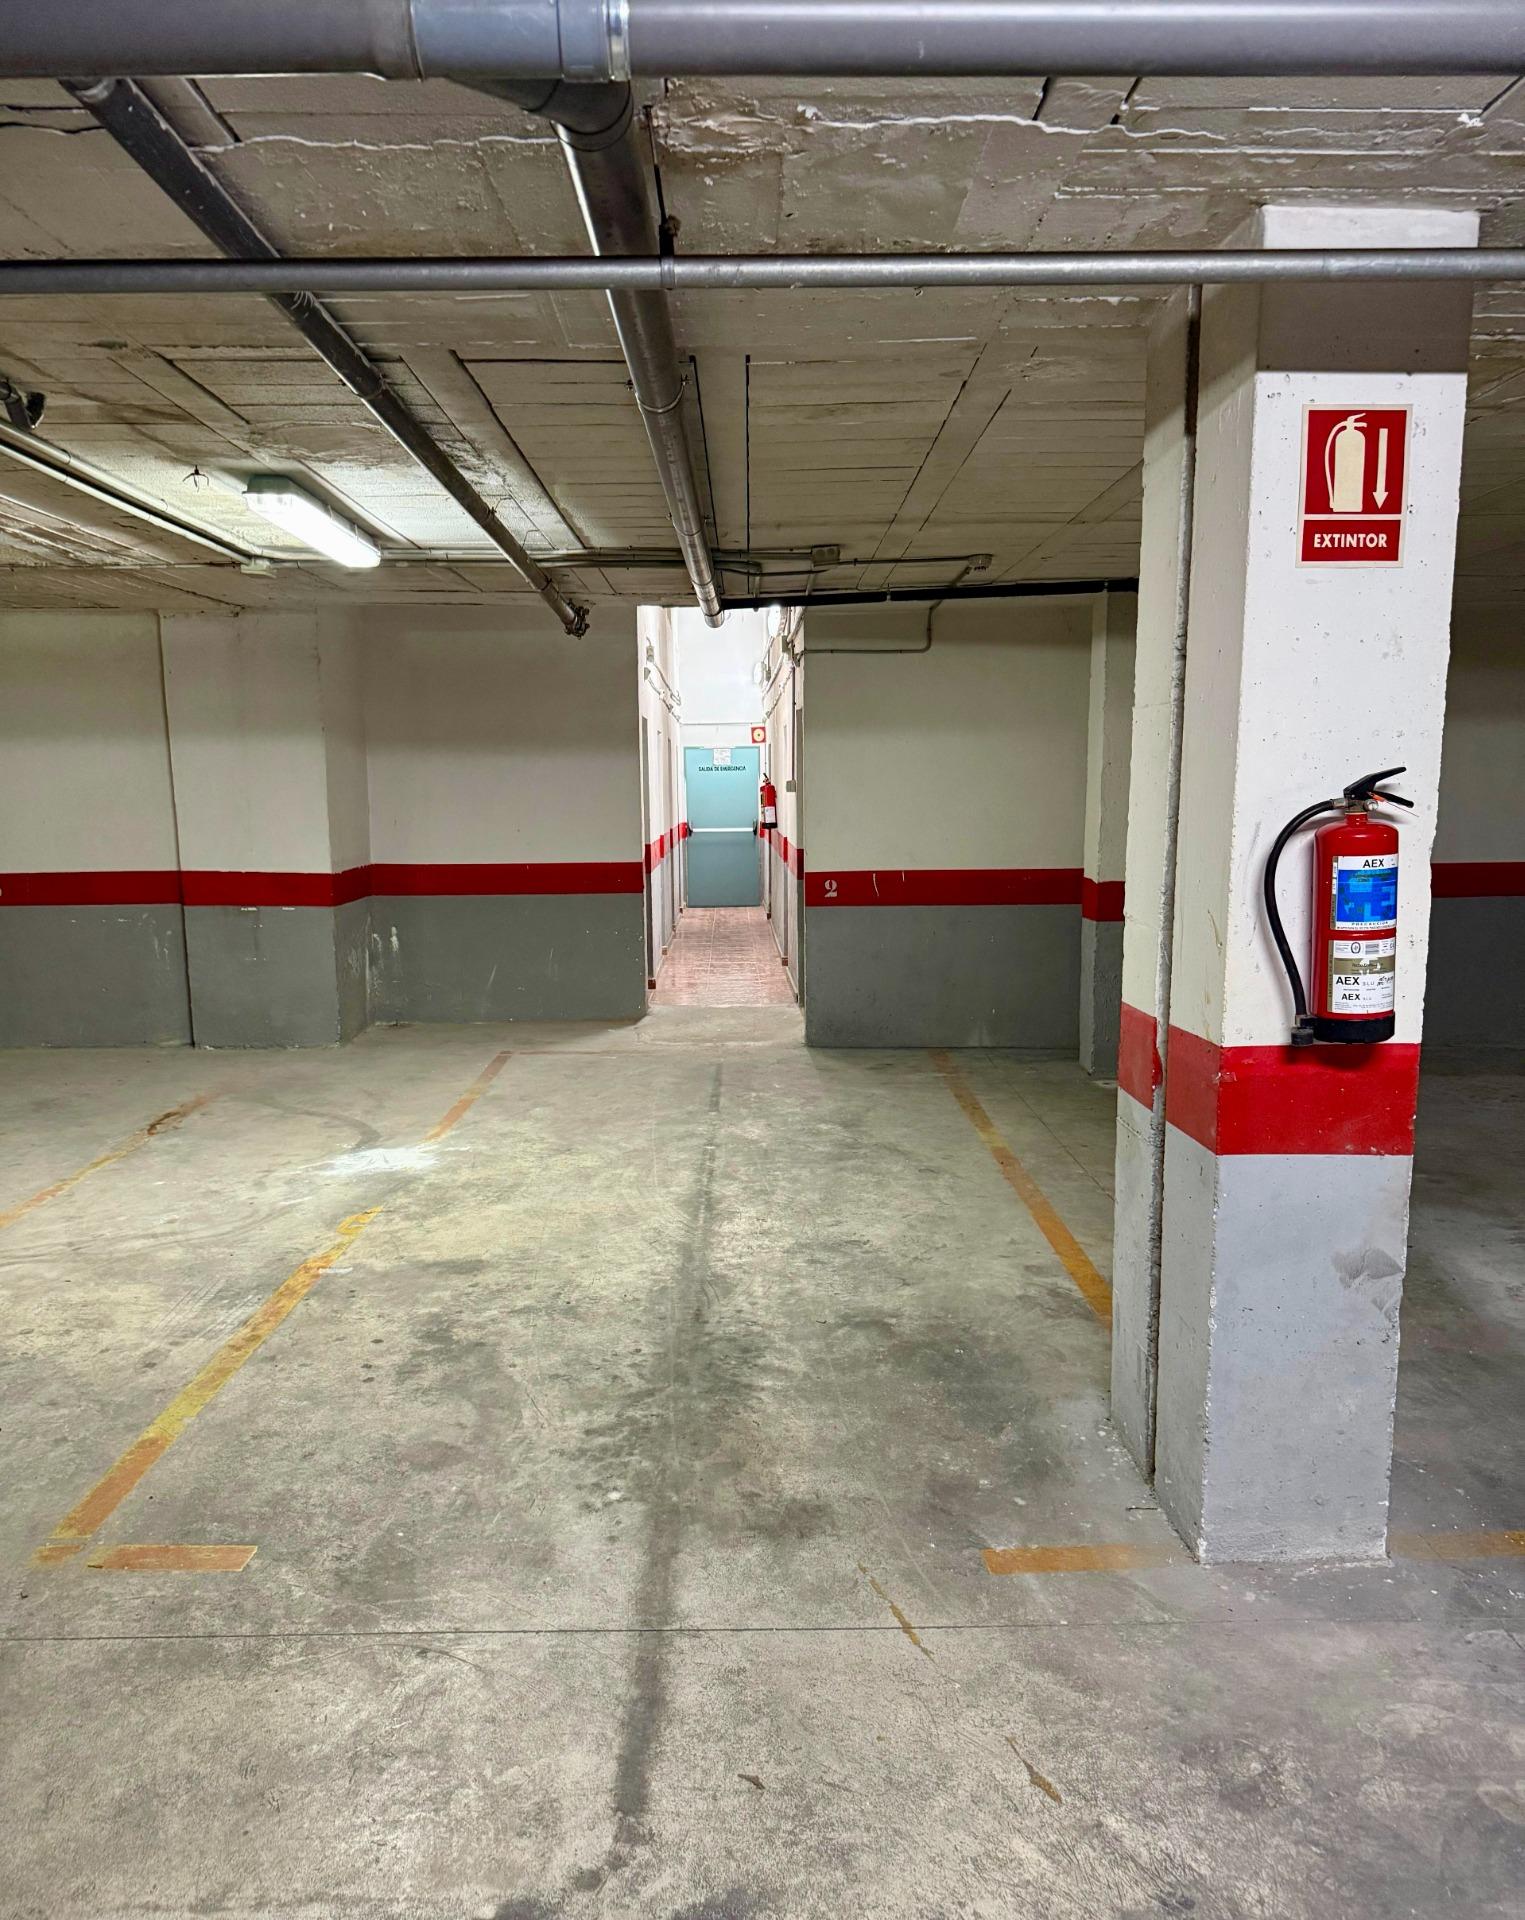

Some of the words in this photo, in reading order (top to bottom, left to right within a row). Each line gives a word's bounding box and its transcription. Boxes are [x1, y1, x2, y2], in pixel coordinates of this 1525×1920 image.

[1313, 533, 1388, 548] EXTINTOR
[1363, 858, 1385, 868] AEX
[824, 879, 838, 898] 2
[1335, 976, 1360, 986] AEX
[1341, 993, 1361, 1001] AEX
